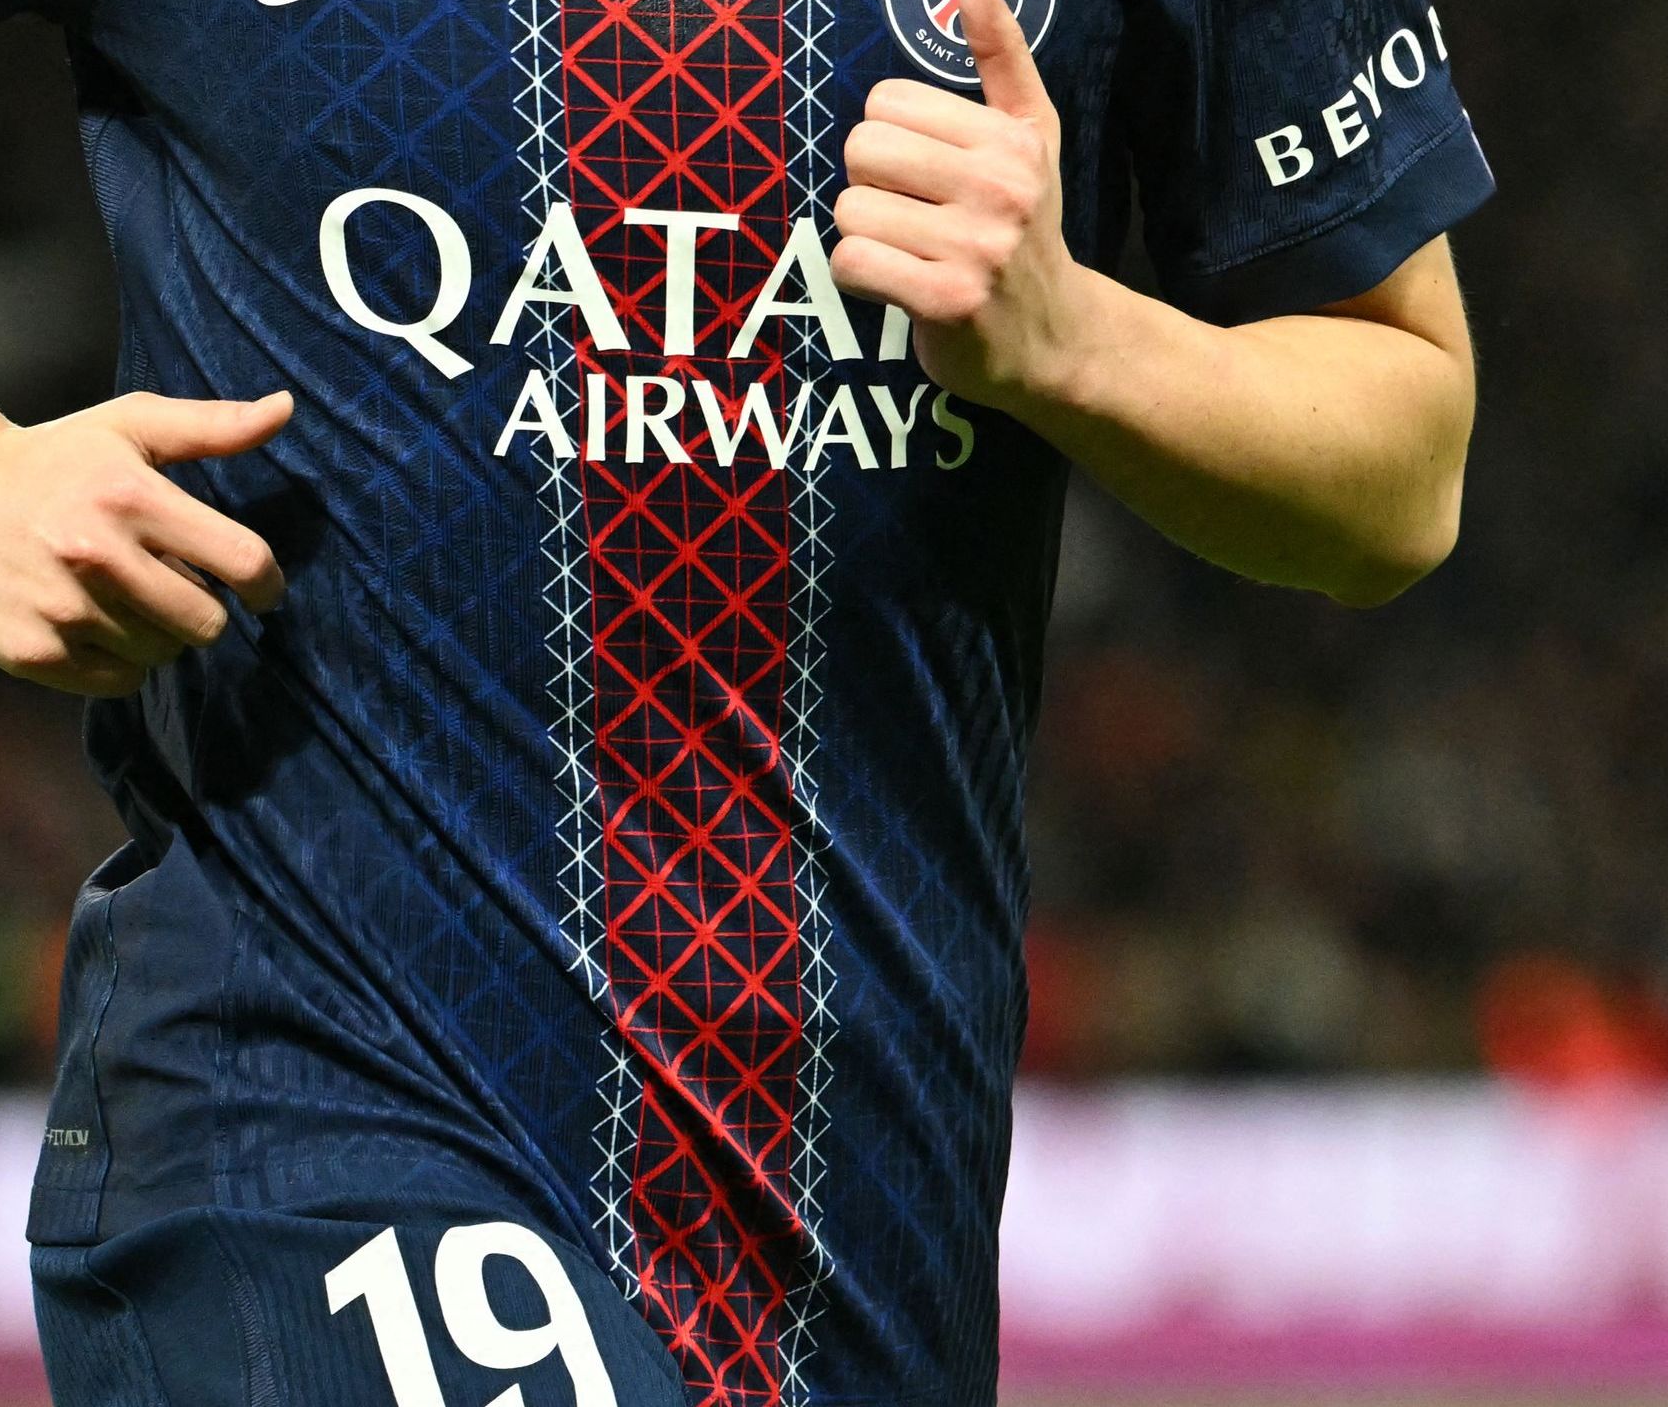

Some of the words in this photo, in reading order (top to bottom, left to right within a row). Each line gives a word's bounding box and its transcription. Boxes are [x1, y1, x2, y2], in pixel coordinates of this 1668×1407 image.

[319, 187, 914, 380] QATA
[493, 368, 975, 472] AIRWAYS
[324, 1220, 619, 1407] 19
